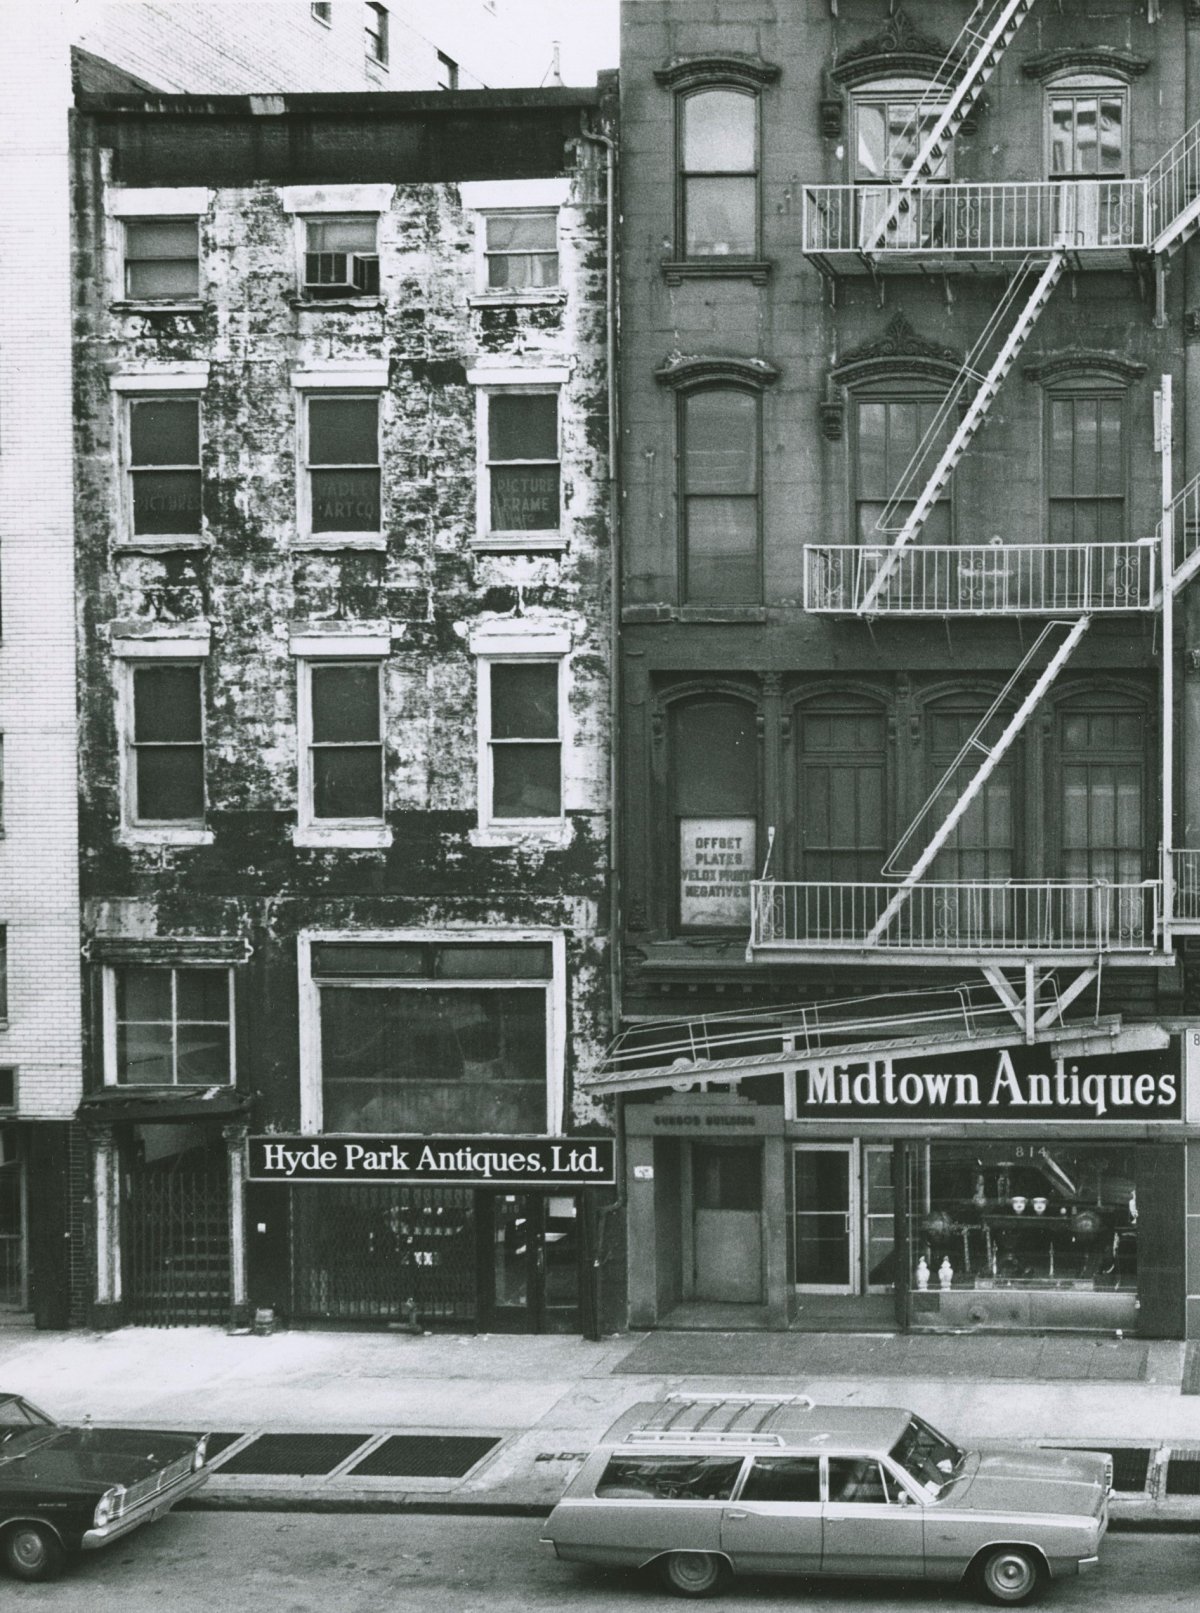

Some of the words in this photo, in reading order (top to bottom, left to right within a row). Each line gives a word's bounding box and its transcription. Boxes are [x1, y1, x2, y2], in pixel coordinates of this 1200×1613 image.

[497, 478, 555, 493] PICTURE
[503, 497, 550, 512] FRAME
[695, 853, 743, 865] PLATES
[805, 1058, 982, 1105] Midtown
[988, 1050, 1177, 1116] Antiques
[1015, 1146, 1047, 1157] 814
[263, 1144, 337, 1176] Hyde
[344, 1144, 410, 1171] Park
[415, 1145, 547, 1178] Antiques,
[550, 1146, 605, 1173] Ltd.
